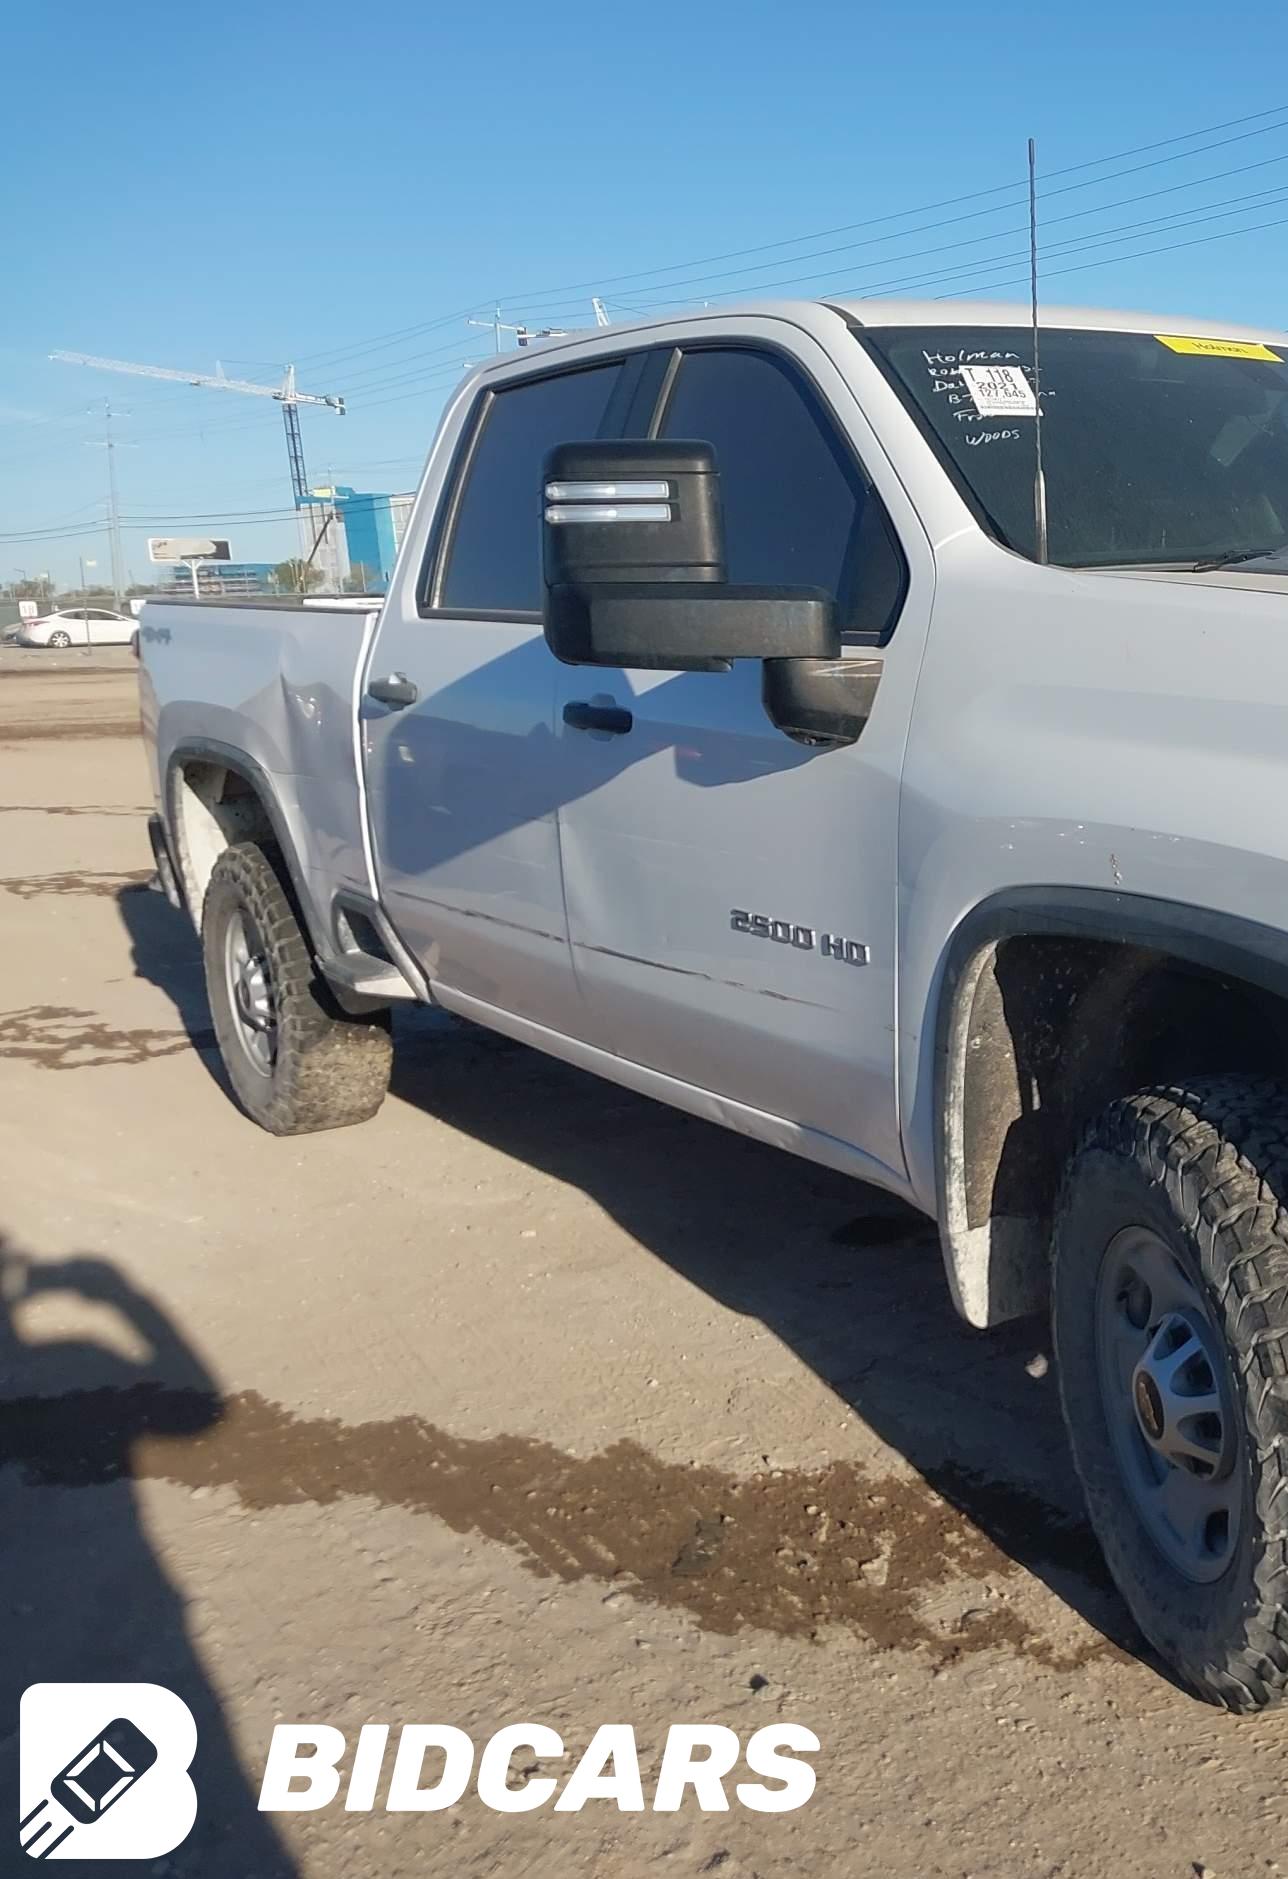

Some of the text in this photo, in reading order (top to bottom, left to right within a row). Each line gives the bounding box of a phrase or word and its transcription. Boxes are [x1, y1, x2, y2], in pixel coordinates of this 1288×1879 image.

[922, 349, 1020, 364] Holman
[964, 368, 976, 381] T
[986, 368, 1014, 382] 118
[976, 381, 1018, 390] 2021
[730, 909, 870, 967] 2500 HD
